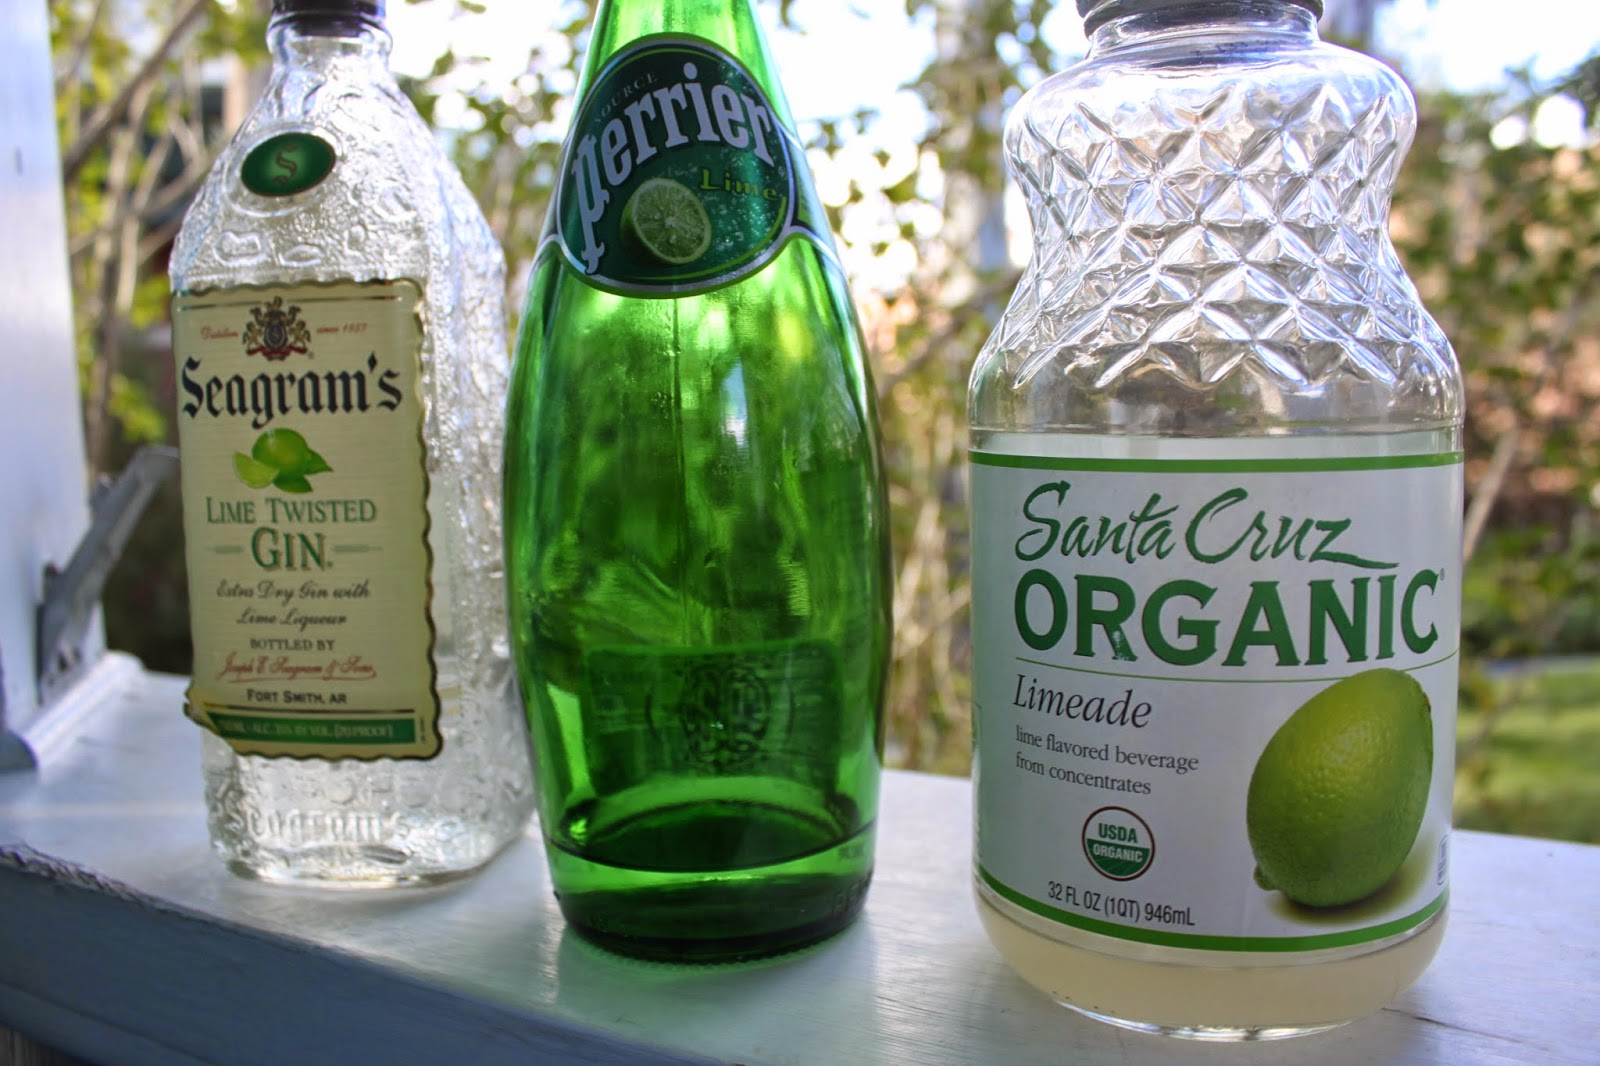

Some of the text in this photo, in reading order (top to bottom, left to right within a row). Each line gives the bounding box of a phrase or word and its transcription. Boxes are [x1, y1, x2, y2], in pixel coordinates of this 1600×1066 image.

[699, 168, 778, 201] Lime
[182, 352, 404, 430] Seagram's
[206, 497, 378, 524] LIME TWISTED
[1014, 480, 1400, 569] Santa Cruz
[216, 578, 371, 606] Extra Dry Gin with
[236, 606, 347, 633] Lime Liqueur
[1014, 568, 1440, 667] ORGANIC
[250, 638, 335, 651] BOTTLED BY
[247, 689, 278, 702] FORT
[329, 693, 348, 704] AR
[1012, 674, 1152, 728] Limeade
[1016, 725, 1199, 774] lime flavored beverage
[1016, 752, 1151, 795] from concentrates
[1098, 823, 1138, 844] USDA
[1093, 844, 1143, 863] ORGANIC
[1048, 881, 1196, 926] 32 FL OZ (1QT) 946mL
